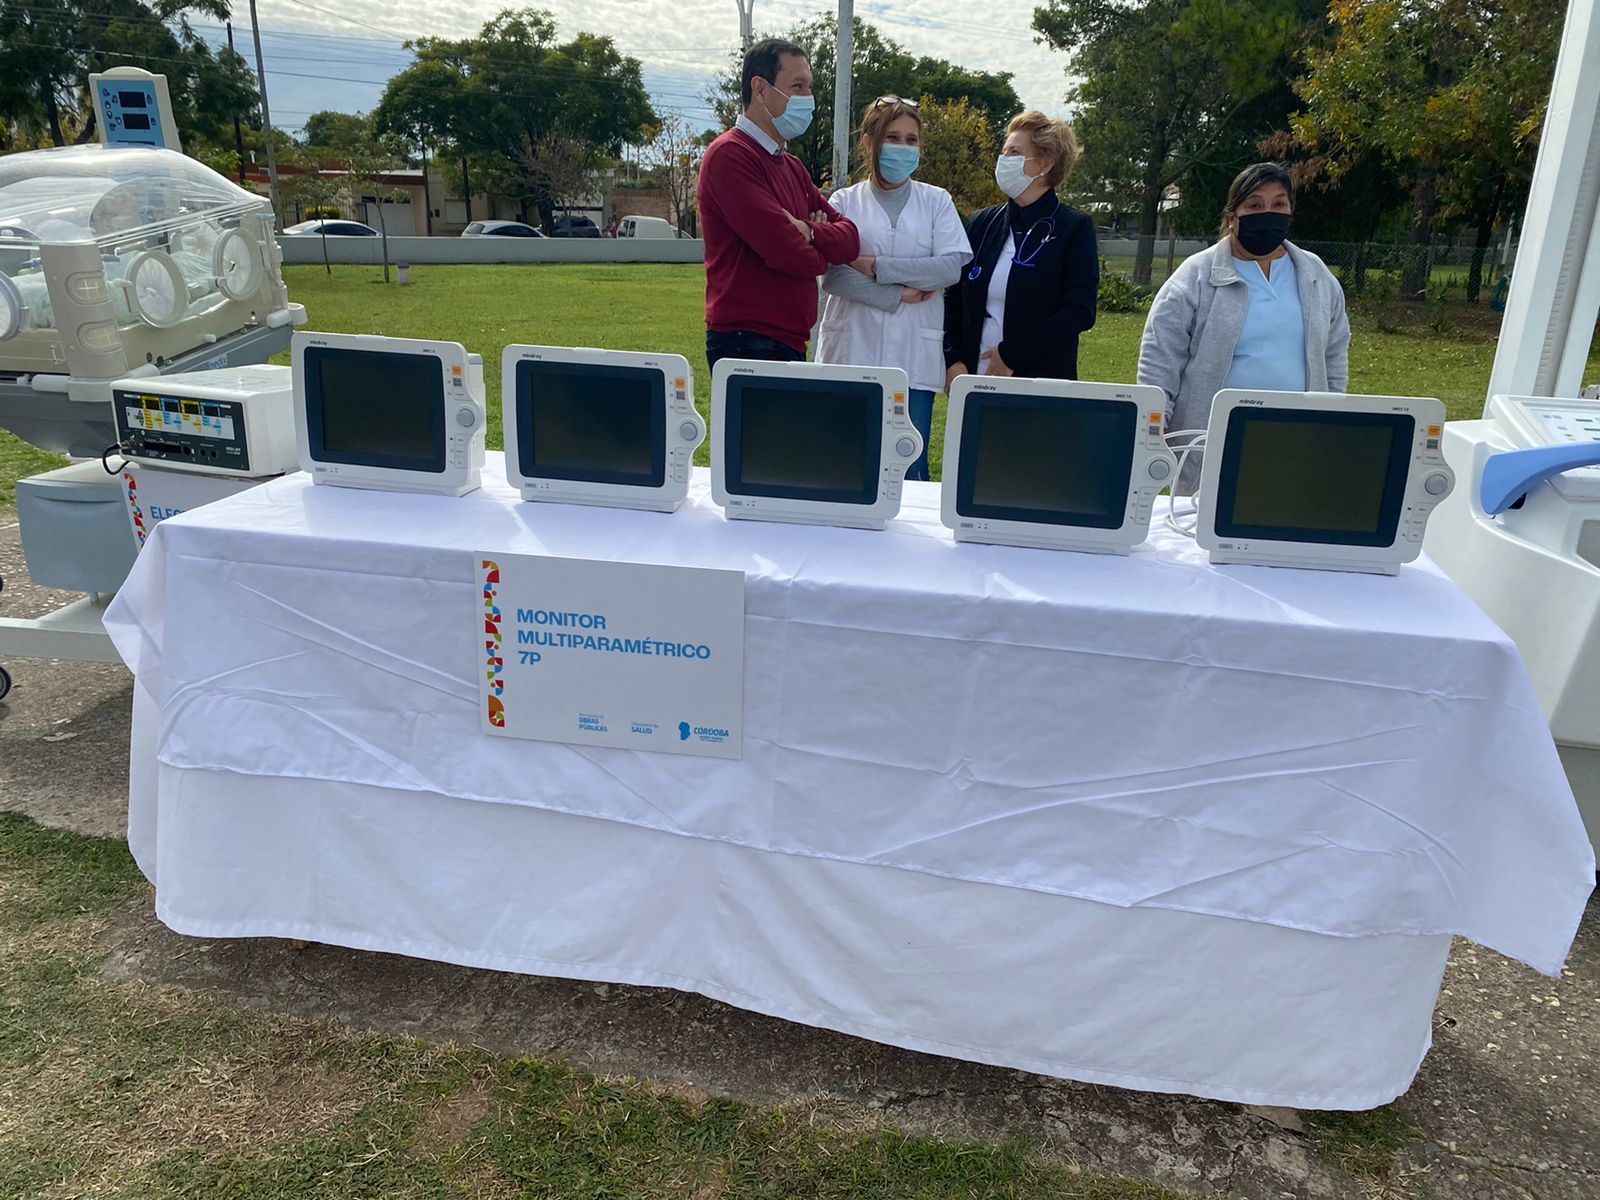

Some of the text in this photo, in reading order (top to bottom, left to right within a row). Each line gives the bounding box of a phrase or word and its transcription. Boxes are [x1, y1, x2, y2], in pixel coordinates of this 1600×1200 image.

[974, 384, 996, 392] mindray
[150, 505, 185, 520] ELEC
[517, 608, 607, 630] MONITOR
[517, 629, 711, 660] MULTIPARAMÉTRICO
[518, 651, 542, 666] 7P
[578, 716, 599, 725] OBRAS
[631, 726, 653, 735] SALUD
[693, 725, 729, 737] CÓRDOBA
